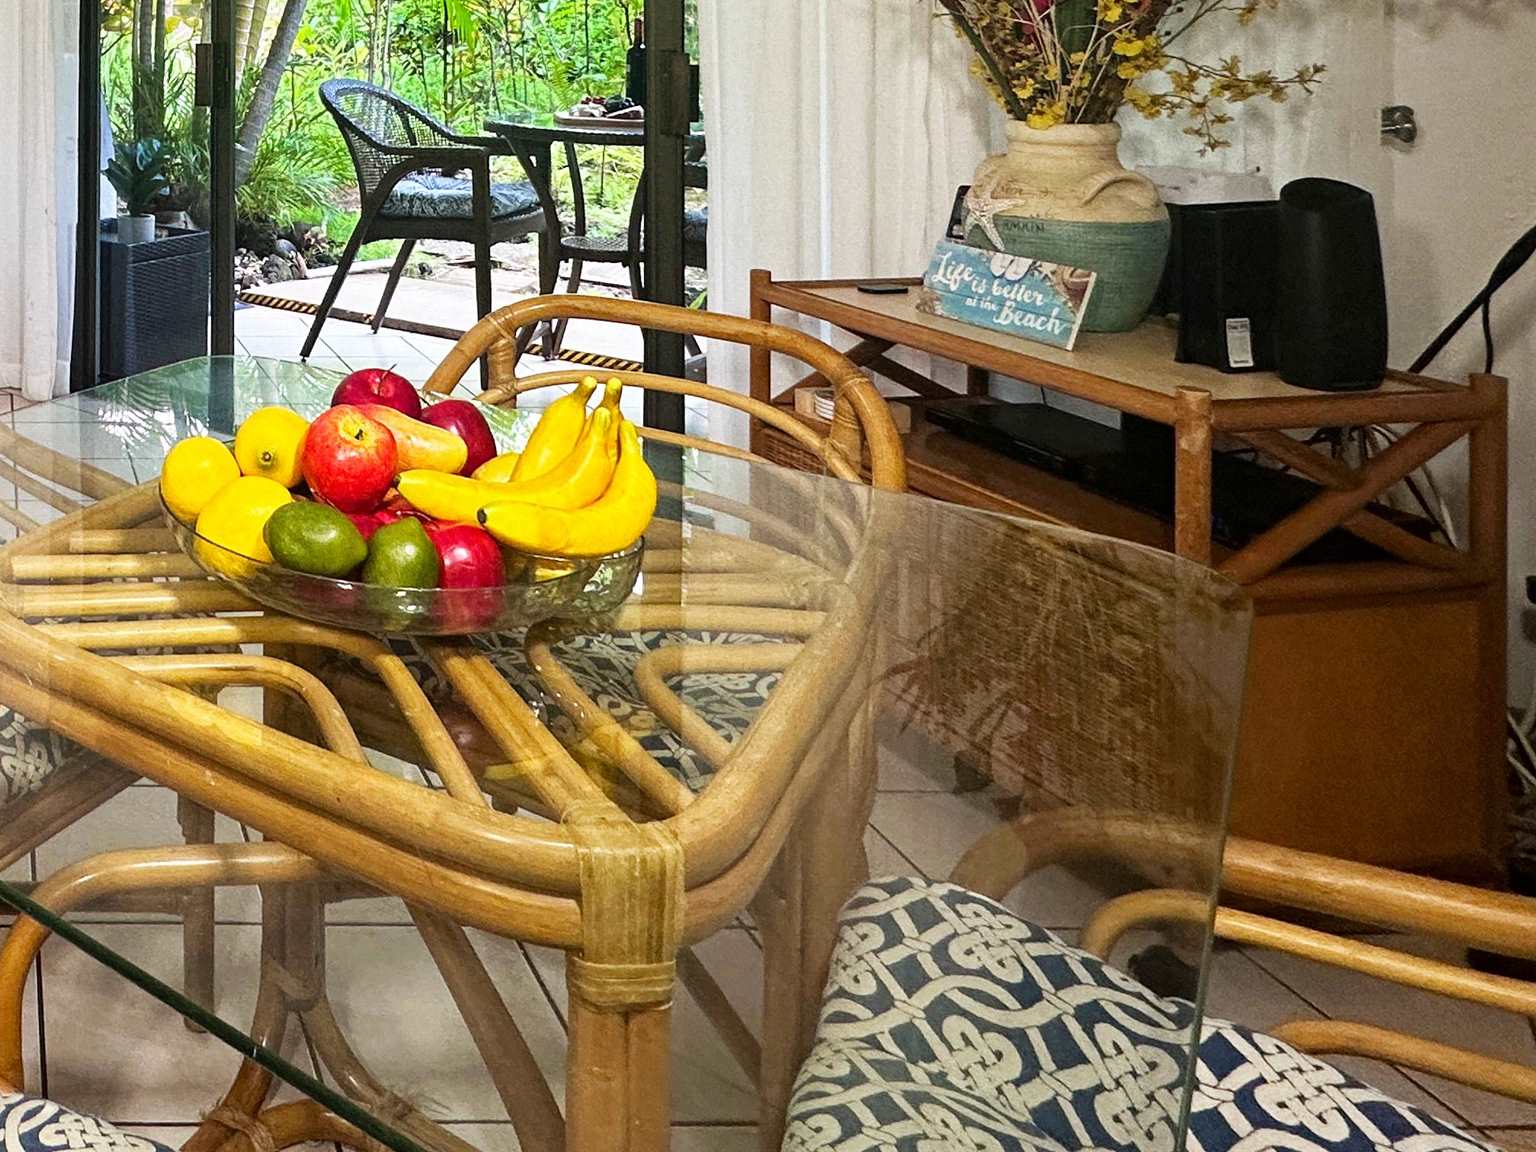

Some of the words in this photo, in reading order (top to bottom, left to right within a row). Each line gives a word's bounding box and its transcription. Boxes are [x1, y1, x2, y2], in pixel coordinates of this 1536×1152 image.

[931, 251, 975, 291] Life
[971, 277, 986, 293] is
[991, 280, 1044, 306] better
[965, 295, 978, 307] at
[979, 296, 999, 311] the
[993, 301, 1066, 334] Beach
